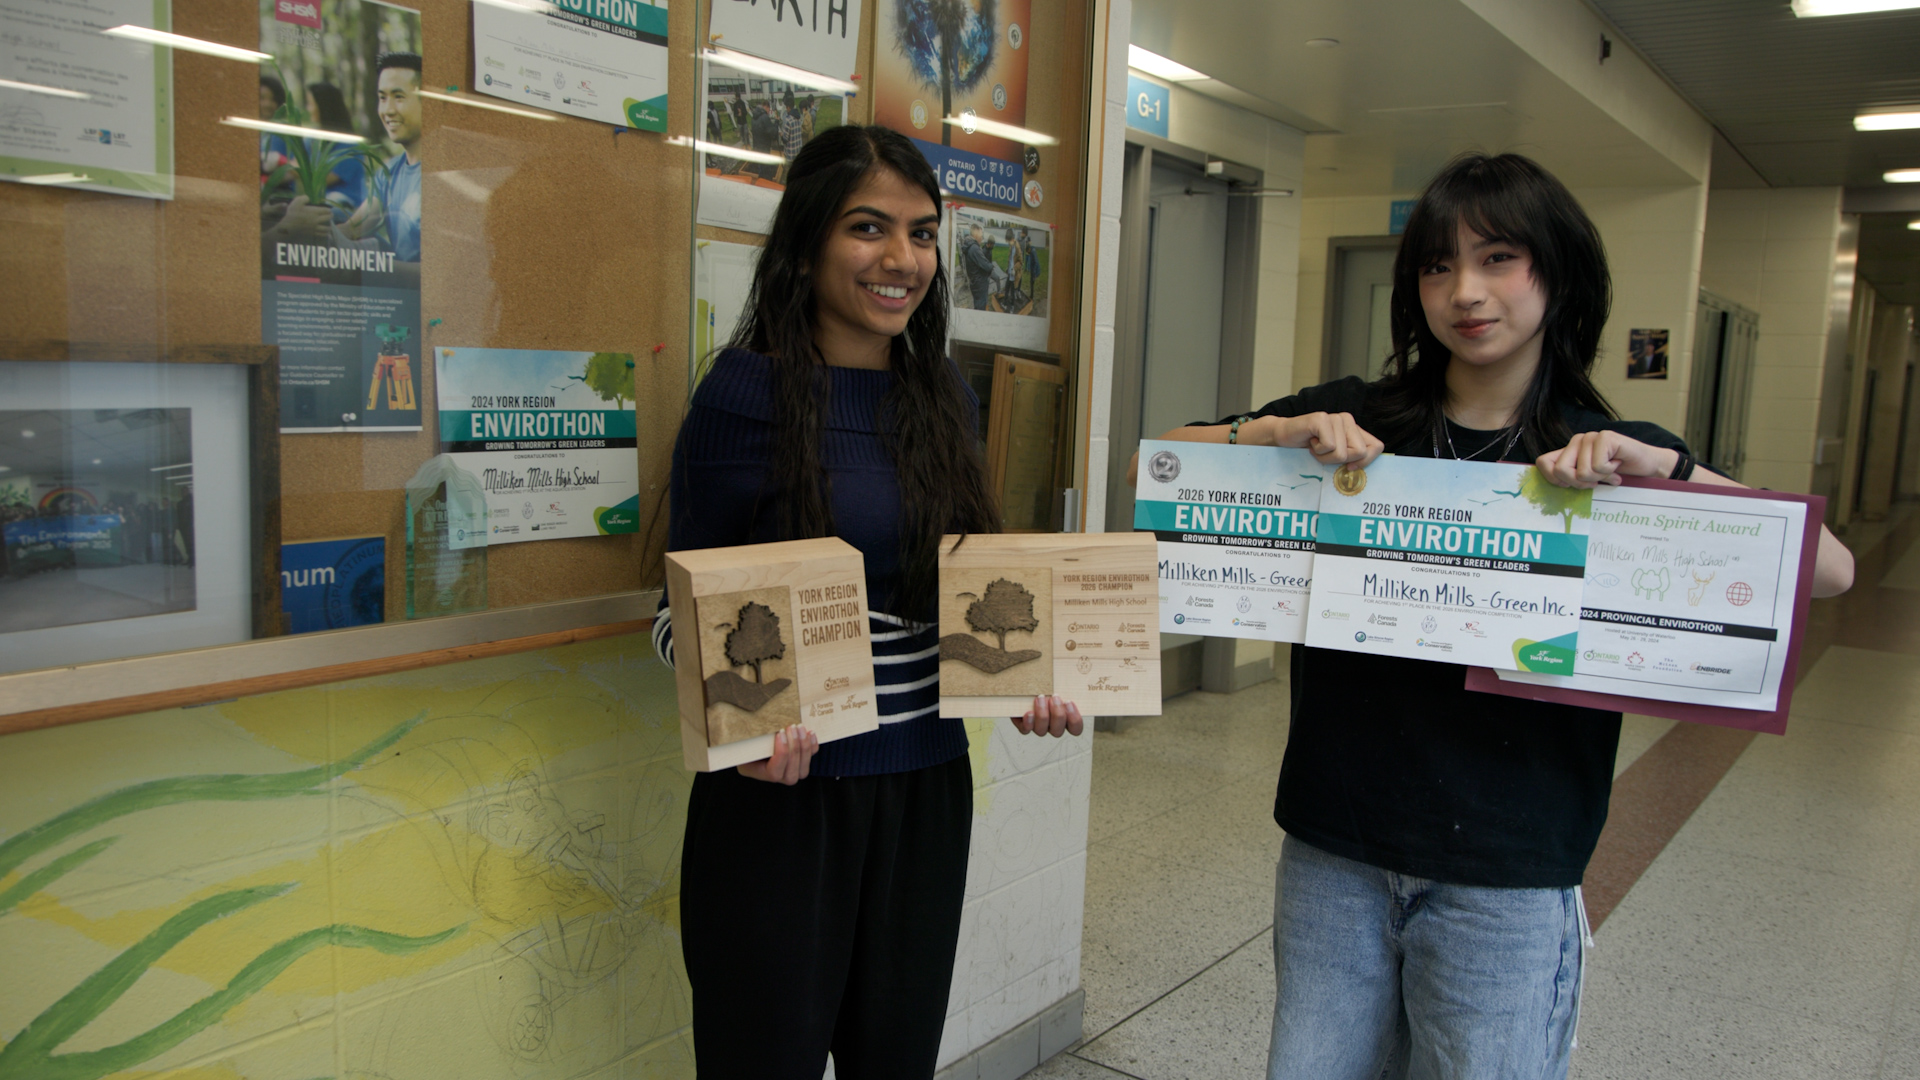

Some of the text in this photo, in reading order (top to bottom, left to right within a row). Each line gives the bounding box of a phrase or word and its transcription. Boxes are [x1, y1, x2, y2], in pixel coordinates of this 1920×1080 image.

[278, 1, 318, 19] SHSM
[555, 0, 637, 26] THON
[547, 20, 590, 37] CONGRATULATIONS
[549, 9, 638, 38] TOMORROW'S GREEN LEADERS
[1137, 92, 1161, 122] G-1
[948, 158, 976, 172] ONTARIO
[945, 169, 1018, 202] ecoschool
[276, 242, 396, 273] ENVIRONMENT
[472, 396, 556, 408] 2024 YORK REGION
[471, 412, 606, 438] ENVIROTHON
[485, 439, 606, 450] GROWING TOMORROW'S GREEN LEADERS
[1158, 457, 1172, 476] 2
[483, 466, 600, 494] Milliken Mills High School
[1177, 488, 1282, 506] 2026 YORK REGION
[1362, 502, 1472, 522] 2026 YORK REGION
[1590, 508, 1762, 536] irothon Spirit Award
[1182, 534, 1218, 544] GROWING
[1220, 536, 1272, 547] TOMORROW'S
[1274, 540, 1300, 550] GREEN
[1358, 518, 1542, 560] ENVIROTHON
[1640, 534, 1662, 542] Presented
[1225, 550, 1282, 558] CONGRATULATIONS
[1366, 550, 1530, 572] GROWING TOMORROW'S GREEN LEADERS
[1588, 542, 1729, 578] Milliken Mills High School
[1062, 574, 1150, 582] YORK REGION ENVIROTHON
[1158, 560, 1218, 582] Milliken
[1222, 567, 1256, 584] Mills
[1411, 566, 1470, 578] CONGRATULATIONS
[798, 582, 858, 604] YORK REGION
[1080, 582, 1133, 591] 2026 CHAMPION
[1364, 574, 1429, 602] Milliken
[1436, 582, 1474, 607] Mills
[1543, 596, 1574, 616] Inc.
[1064, 596, 1148, 608] Milliken Mills High School
[800, 600, 860, 624] ENVIROTHON
[1377, 614, 1398, 622] Forests
[1454, 607, 1487, 615] ENVIROTHON
[1488, 610, 1522, 618] COMPETITION
[1600, 612, 1656, 626] PROVINCIAL
[1659, 618, 1724, 633] ENVIROTHON
[802, 620, 862, 646] CHAMPION
[1627, 630, 1648, 638] University
[1655, 632, 1676, 640] Waterloo
[1424, 642, 1453, 650] Conservation
[1543, 656, 1564, 664] Region
[1594, 653, 1620, 661] ONTARIO
[1696, 665, 1732, 676] ENBRIDGE
[1105, 684, 1129, 692] Region
[817, 701, 834, 710] Forests
[817, 708, 834, 716] Canada
[840, 700, 868, 712] York Region
